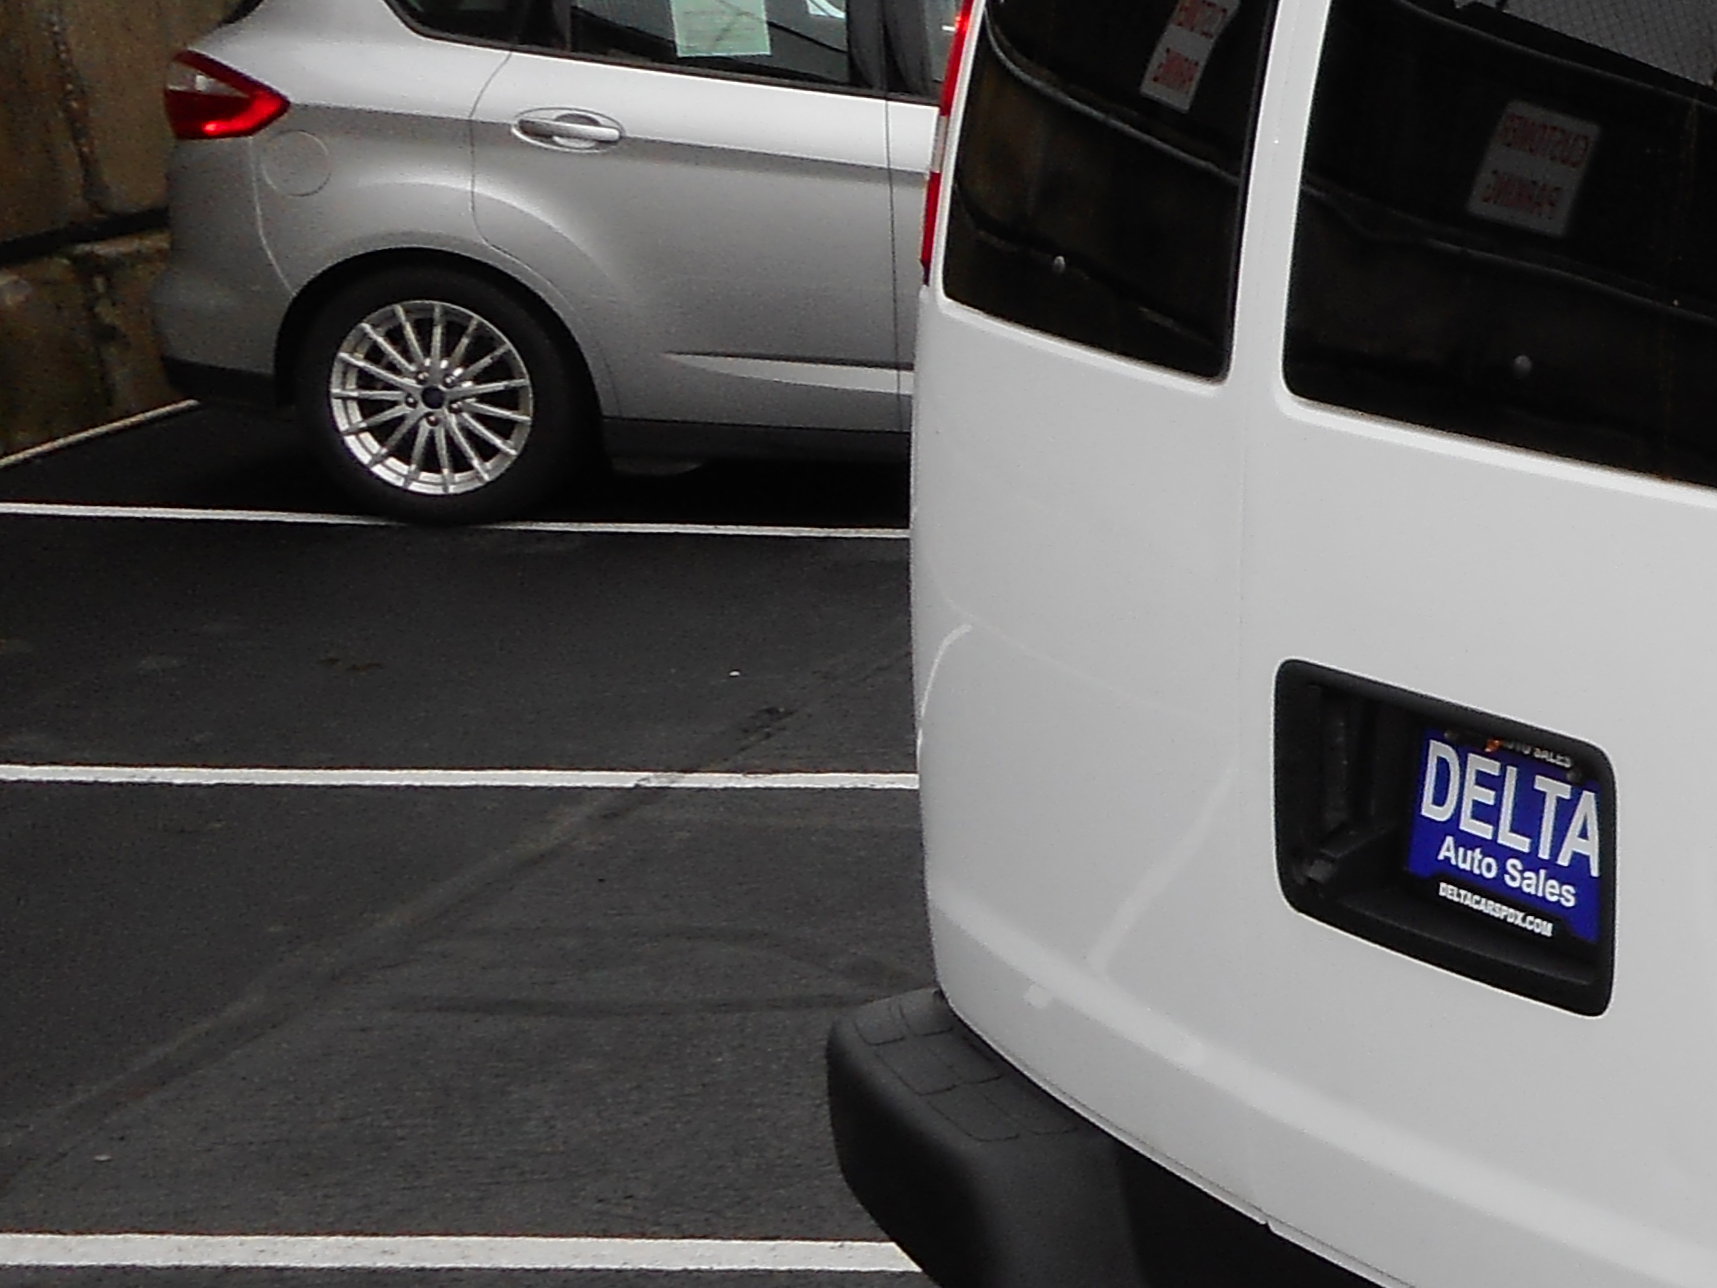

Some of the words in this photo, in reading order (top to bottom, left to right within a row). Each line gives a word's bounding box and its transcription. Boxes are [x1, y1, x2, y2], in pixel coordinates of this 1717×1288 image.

[1420, 738, 1600, 878] DELTA
[1437, 835, 1498, 879] Auto
[1503, 857, 1577, 908] Sales
